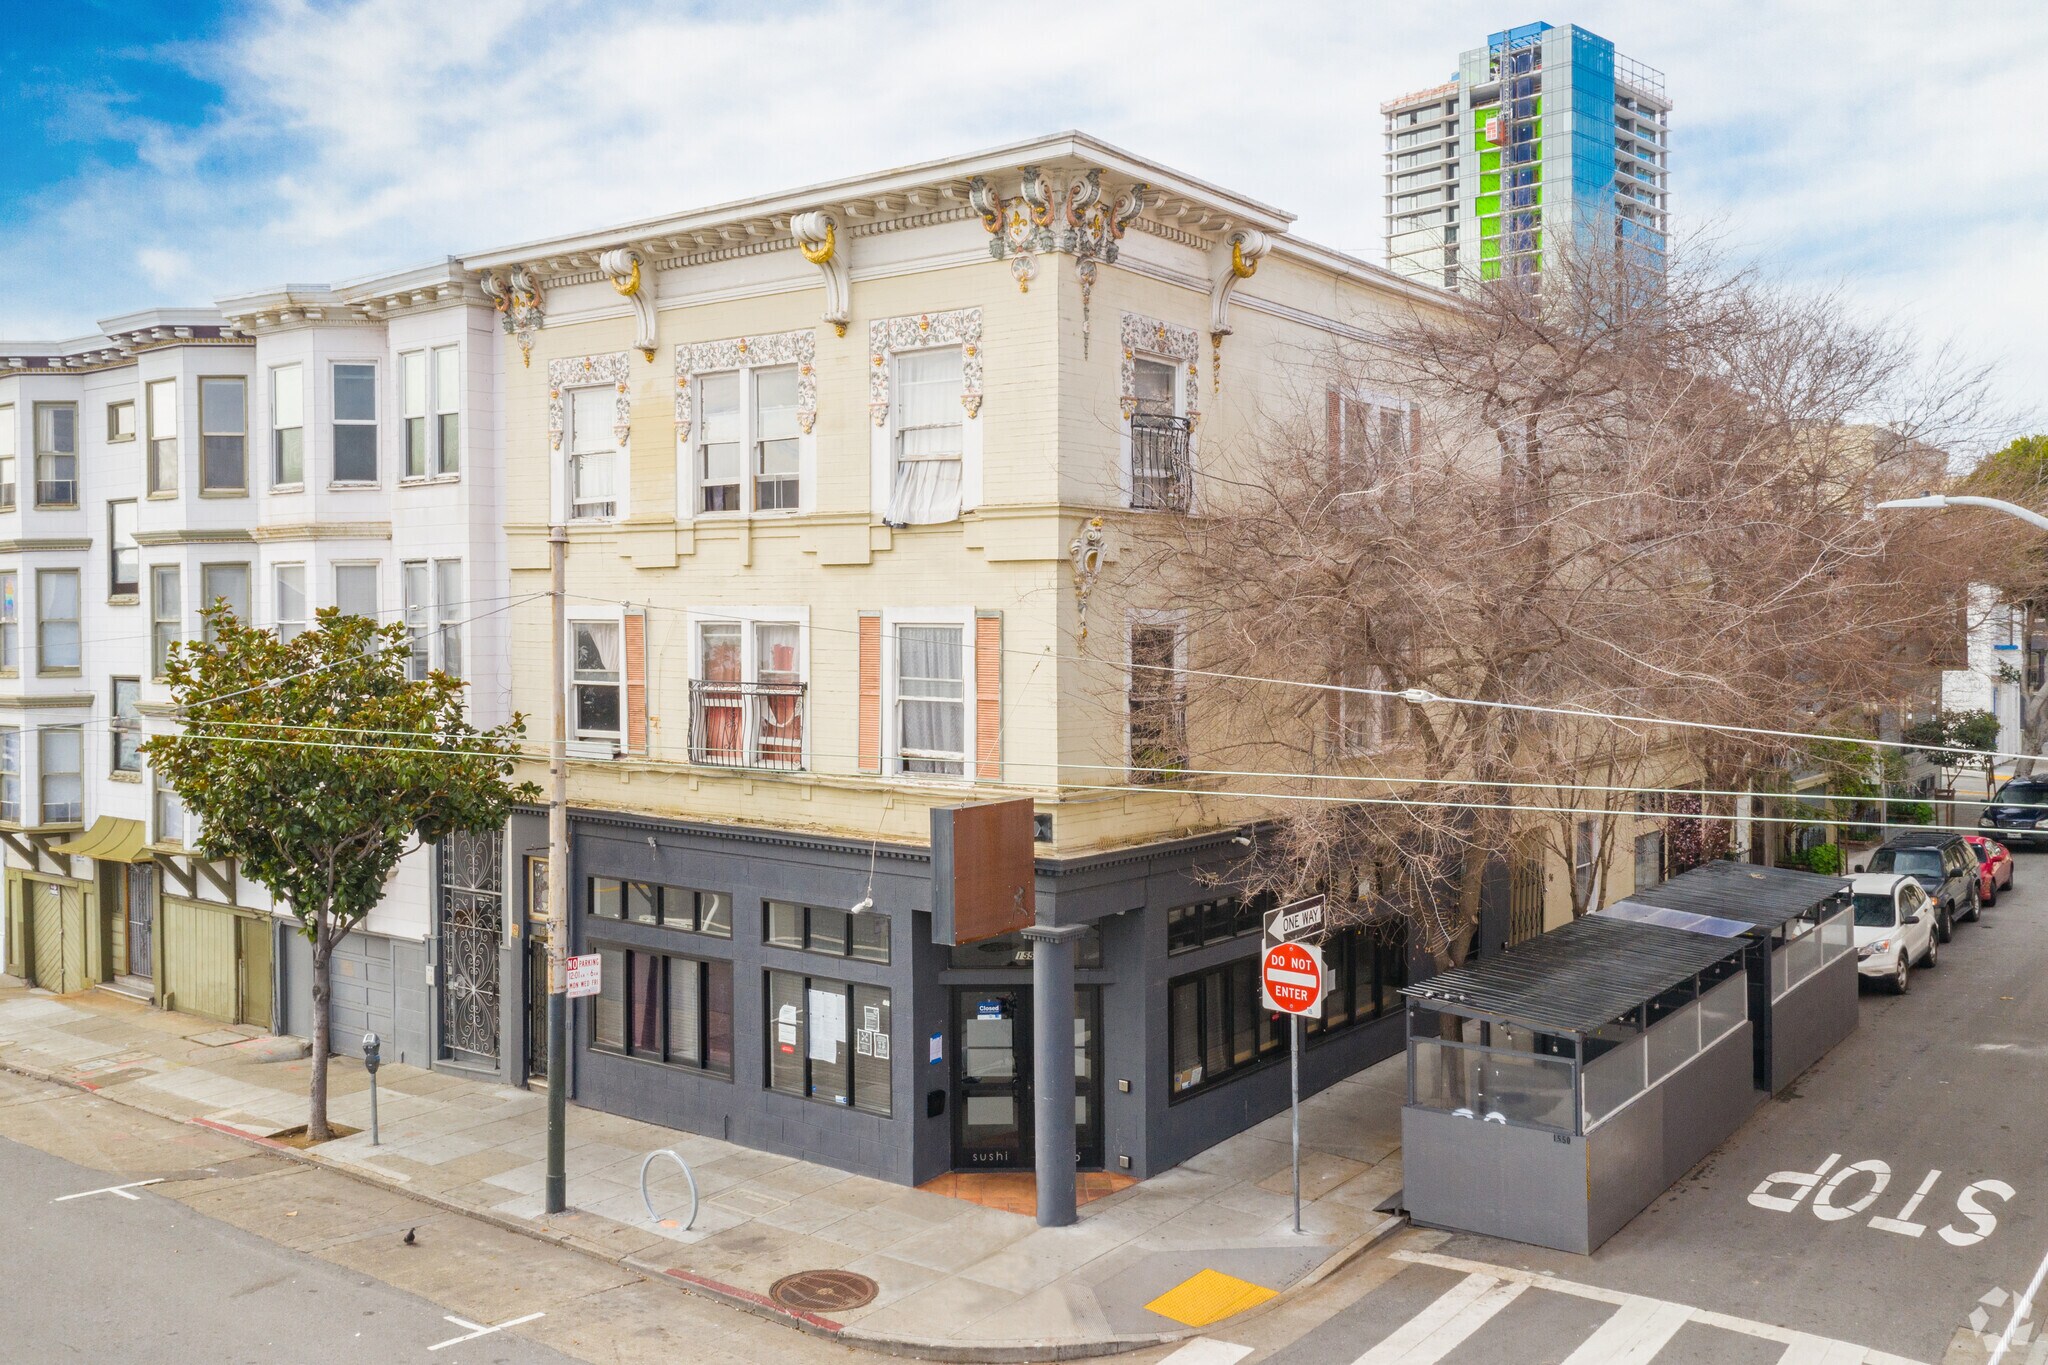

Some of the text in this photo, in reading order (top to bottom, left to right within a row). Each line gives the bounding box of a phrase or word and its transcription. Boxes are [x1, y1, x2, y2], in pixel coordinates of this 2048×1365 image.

[1283, 907, 1319, 931] ONE WAY
[567, 958, 599, 970] NO PARKING
[1271, 954, 1312, 971] DO NOT
[1275, 985, 1308, 1001] ENTER
[1553, 1133, 1570, 1144] 1550
[972, 1151, 1008, 1161] sushi
[1747, 1153, 2016, 1246] STOP
